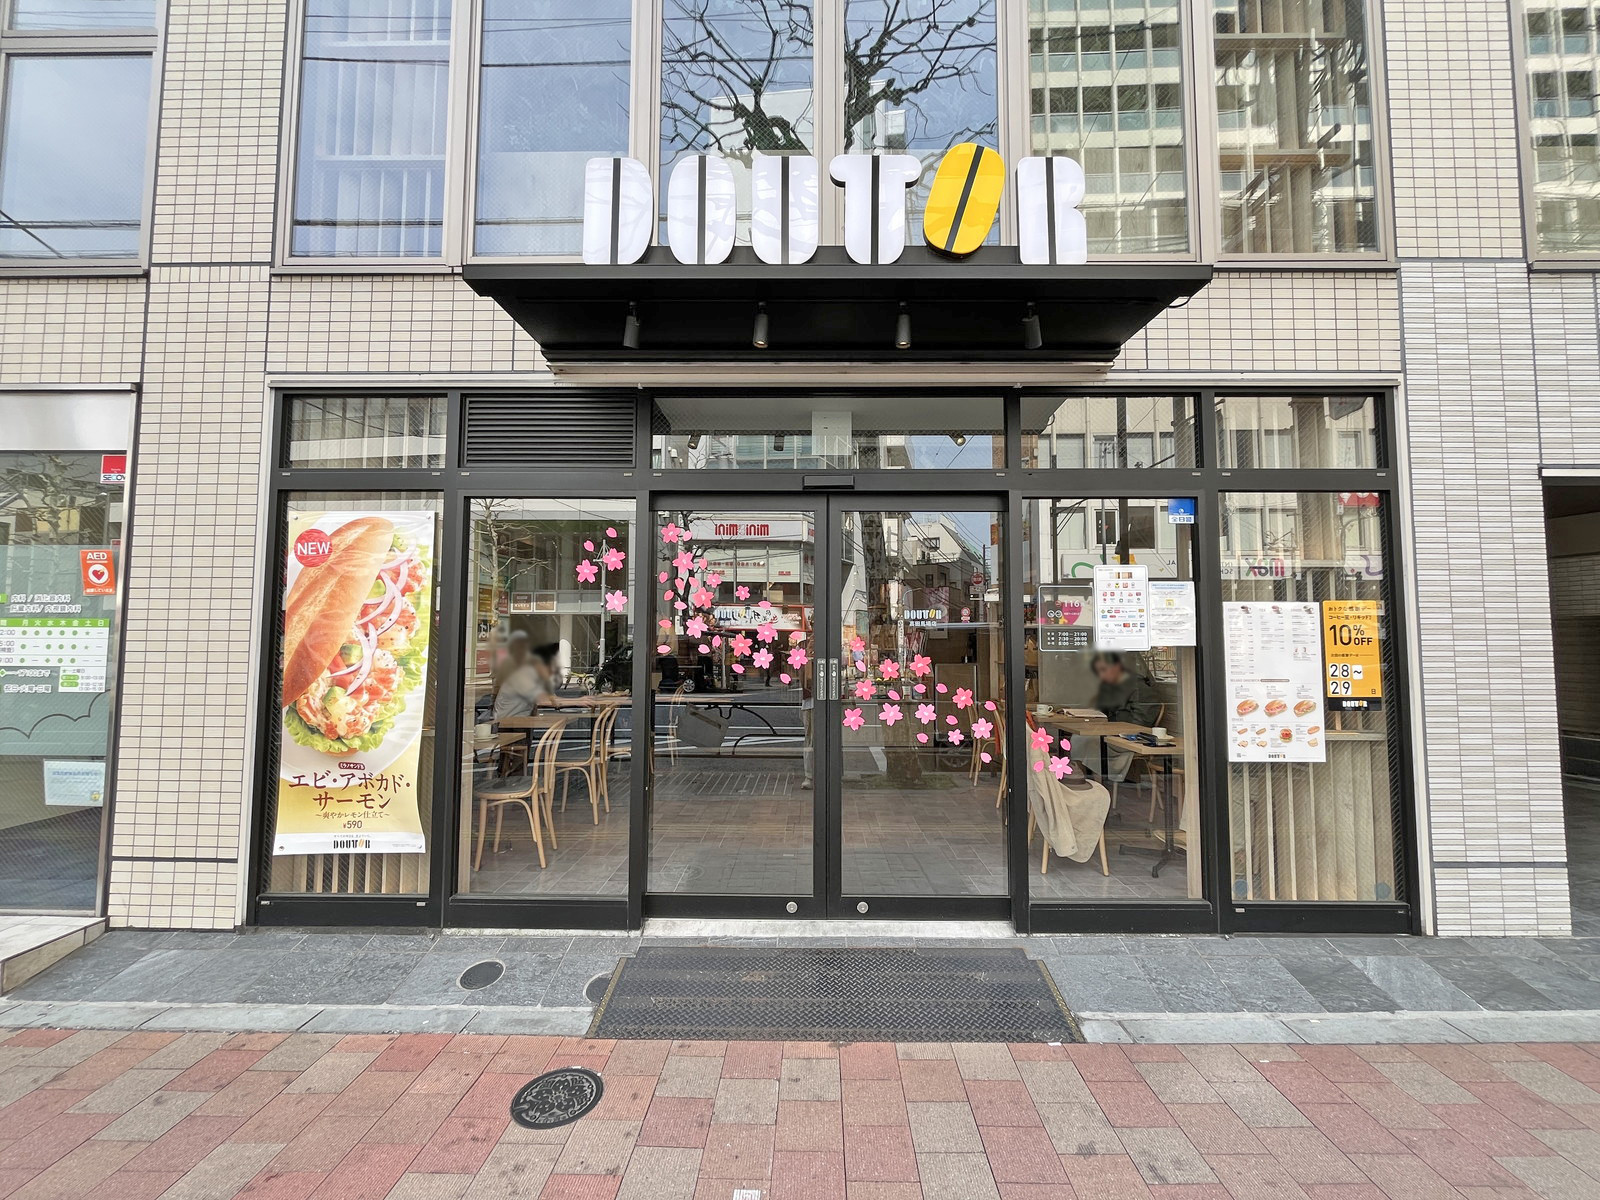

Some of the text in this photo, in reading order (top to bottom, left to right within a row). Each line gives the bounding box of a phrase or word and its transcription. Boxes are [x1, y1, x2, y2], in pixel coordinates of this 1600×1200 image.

[582, 142, 1087, 266] DOUTOR
[297, 541, 331, 556] NEW
[86, 552, 108, 560] AED
[904, 608, 942, 620] DOUTOR
[1353, 637, 1373, 646] OFF
[312, 791, 391, 811] サーモン
[343, 820, 363, 829] ¥590
[333, 839, 371, 849] DOUTOR
